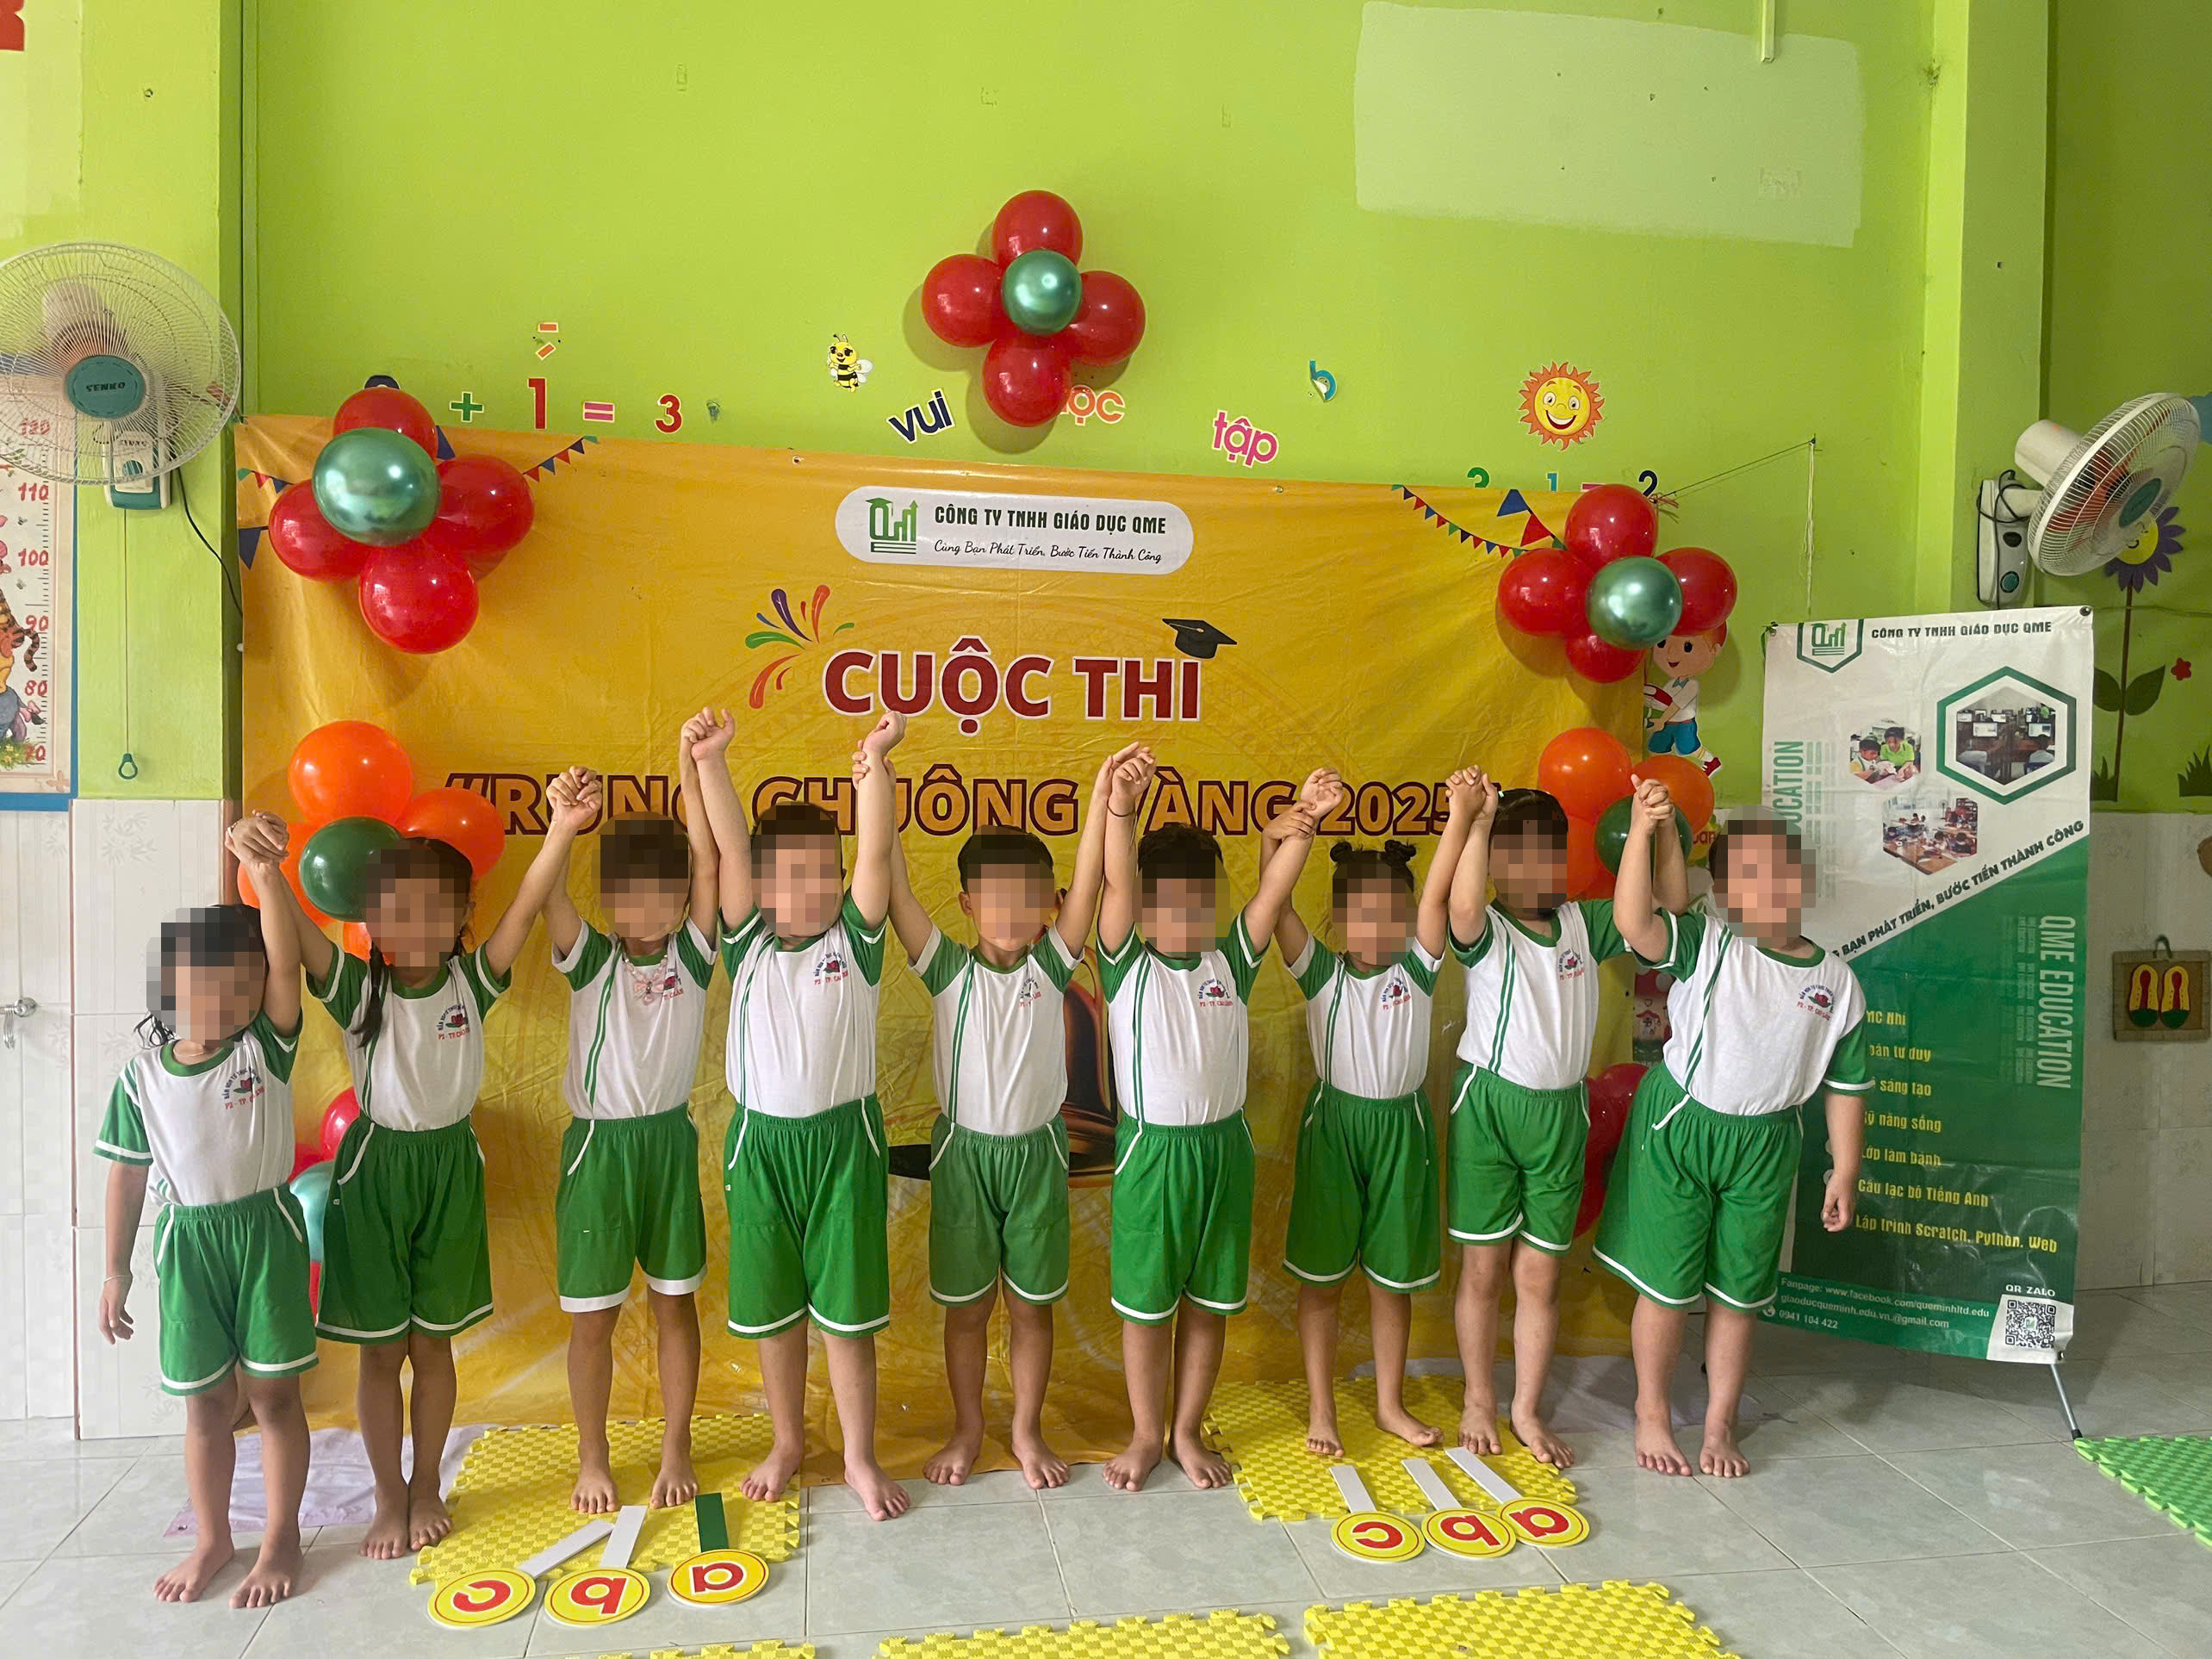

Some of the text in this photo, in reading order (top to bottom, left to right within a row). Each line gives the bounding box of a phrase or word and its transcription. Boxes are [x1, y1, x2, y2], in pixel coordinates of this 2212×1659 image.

[86, 382, 126, 392] SENKO
[527, 376, 547, 429] 1
[655, 394, 682, 433] 3
[1060, 385, 1125, 425] ọc
[886, 388, 956, 444] vui
[1211, 409, 1279, 468] tập
[18, 482, 48, 502] 110
[935, 503, 1166, 535] CÔNG TY TNHH GIÁO DỤC QME
[18, 548, 49, 567] 100
[934, 539, 960, 556] Cùng
[965, 541, 986, 556] Bạn
[989, 542, 1015, 554] Phát
[1103, 547, 1134, 560] Thành
[1138, 549, 1163, 564] Công
[25, 615, 49, 632] 90
[1872, 622, 2052, 639] CÔNG TY TNHH GIÁO DỤC QME
[25, 680, 48, 697] 80
[823, 635, 1202, 735] CUỘC THI
[1842, 935, 1867, 954] BẠN
[1867, 919, 1897, 941] PHÁT
[1936, 879, 1970, 904] BƯỚC
[1971, 864, 1999, 886] TIẾN
[2000, 841, 2044, 872] THÀNH
[2046, 820, 2084, 848] CÔNG
[2036, 915, 2076, 1089] QME EDUCATION
[1869, 1043, 1890, 1058] oán
[1909, 1047, 1931, 1062] duy
[1880, 1078, 1908, 1095] sáng
[1964, 1192, 1989, 1208] Anh
[2029, 1235, 2057, 1253] Web
[1781, 1277, 1823, 1292] Fanpage:
[2005, 1284, 2056, 1297] QR ZALO
[1779, 1309, 1838, 1329] 0941 104 422
